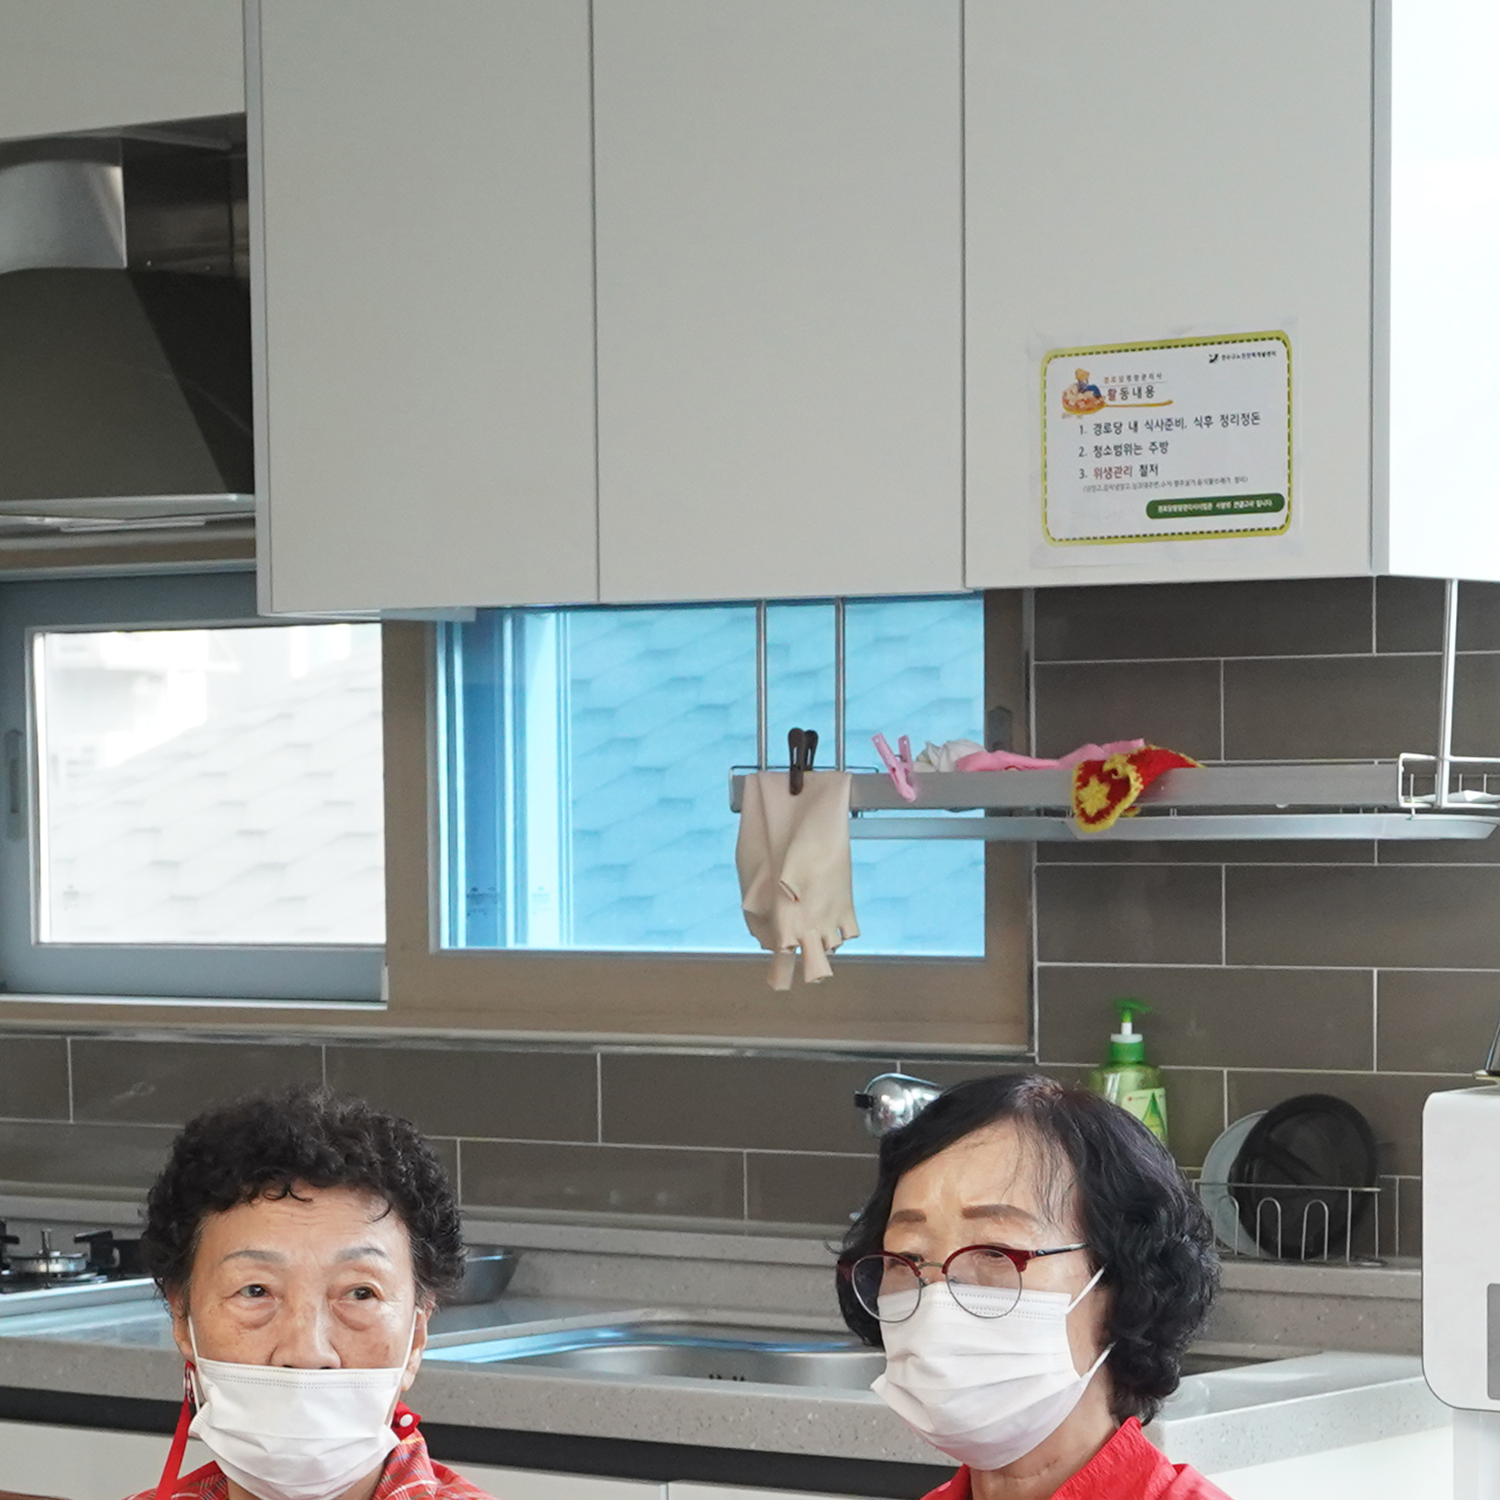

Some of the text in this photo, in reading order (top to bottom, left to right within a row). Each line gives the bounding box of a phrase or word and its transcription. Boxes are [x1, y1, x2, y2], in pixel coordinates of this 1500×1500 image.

[1106, 384, 1156, 402] 활동내용
[1079, 424, 1088, 436] 1.
[1093, 420, 1124, 437] 경로당
[1127, 420, 1139, 434] 내
[1193, 414, 1214, 430] 식후
[1219, 411, 1262, 429] 정리정돈
[1078, 440, 1170, 459] 2. 청소범위는 주방
[1078, 463, 1159, 480] 3. 위생관리 철저
